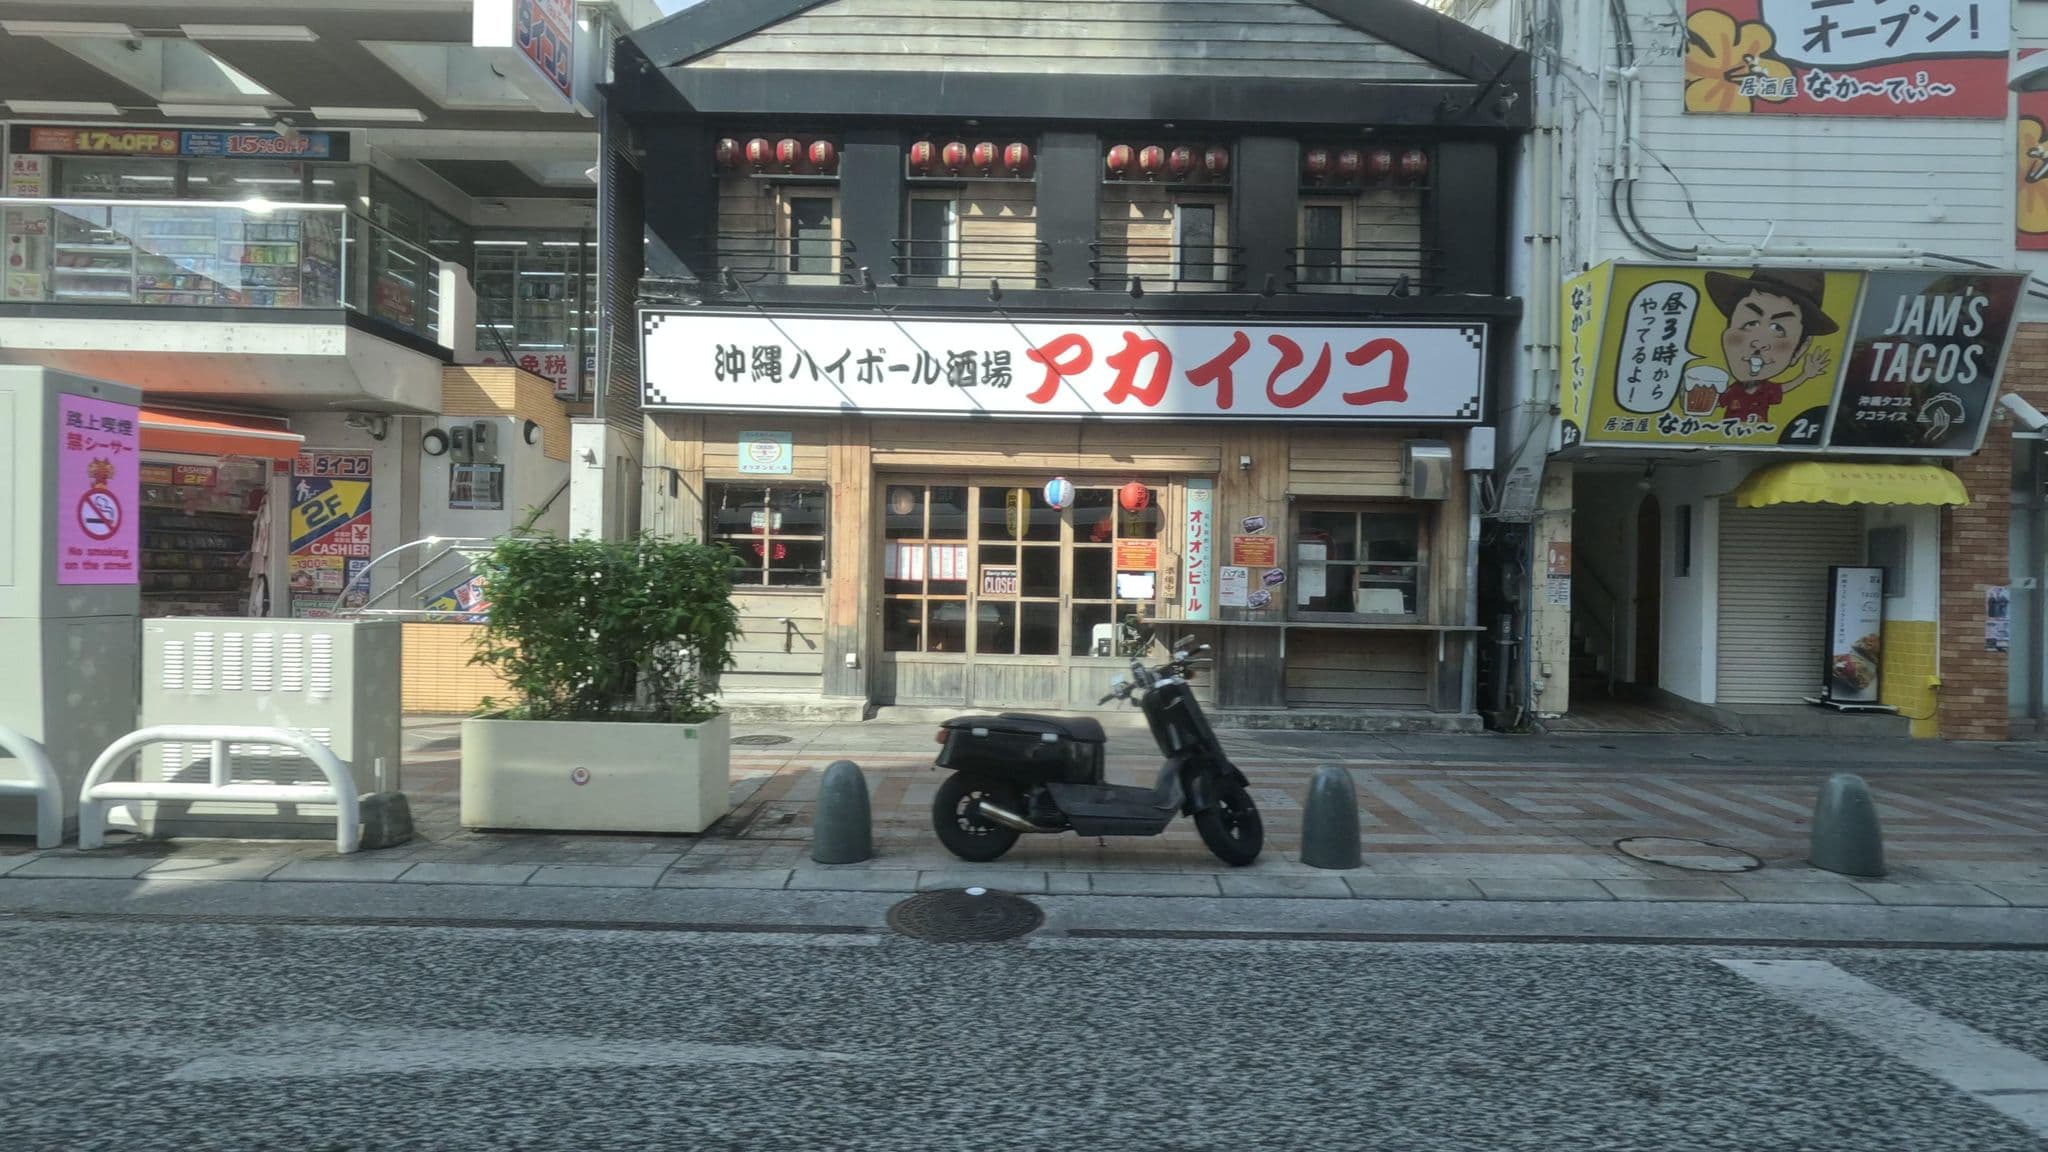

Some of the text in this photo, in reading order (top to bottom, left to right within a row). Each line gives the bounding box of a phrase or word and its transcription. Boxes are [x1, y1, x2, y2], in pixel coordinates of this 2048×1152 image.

[1741, 78, 1798, 97] 居酒屋
[1884, 286, 1988, 337] JAM'S
[1652, 292, 1687, 400] 昼3時から
[714, 331, 1409, 409] 沖縄ハイボール酒場 アカインコ
[1870, 342, 1984, 384] TACOS
[66, 411, 133, 436] 路上喫煙
[1604, 418, 1649, 432] 居酒屋
[1855, 411, 1908, 421] タコライス
[1564, 426, 1577, 446] 2F
[1791, 419, 1820, 438] 2F
[316, 456, 370, 475] ダイコク
[301, 494, 342, 529] 2F
[68, 547, 83, 556] No
[311, 543, 370, 556] CASHIER
[1187, 509, 1203, 611] オリオンビール
